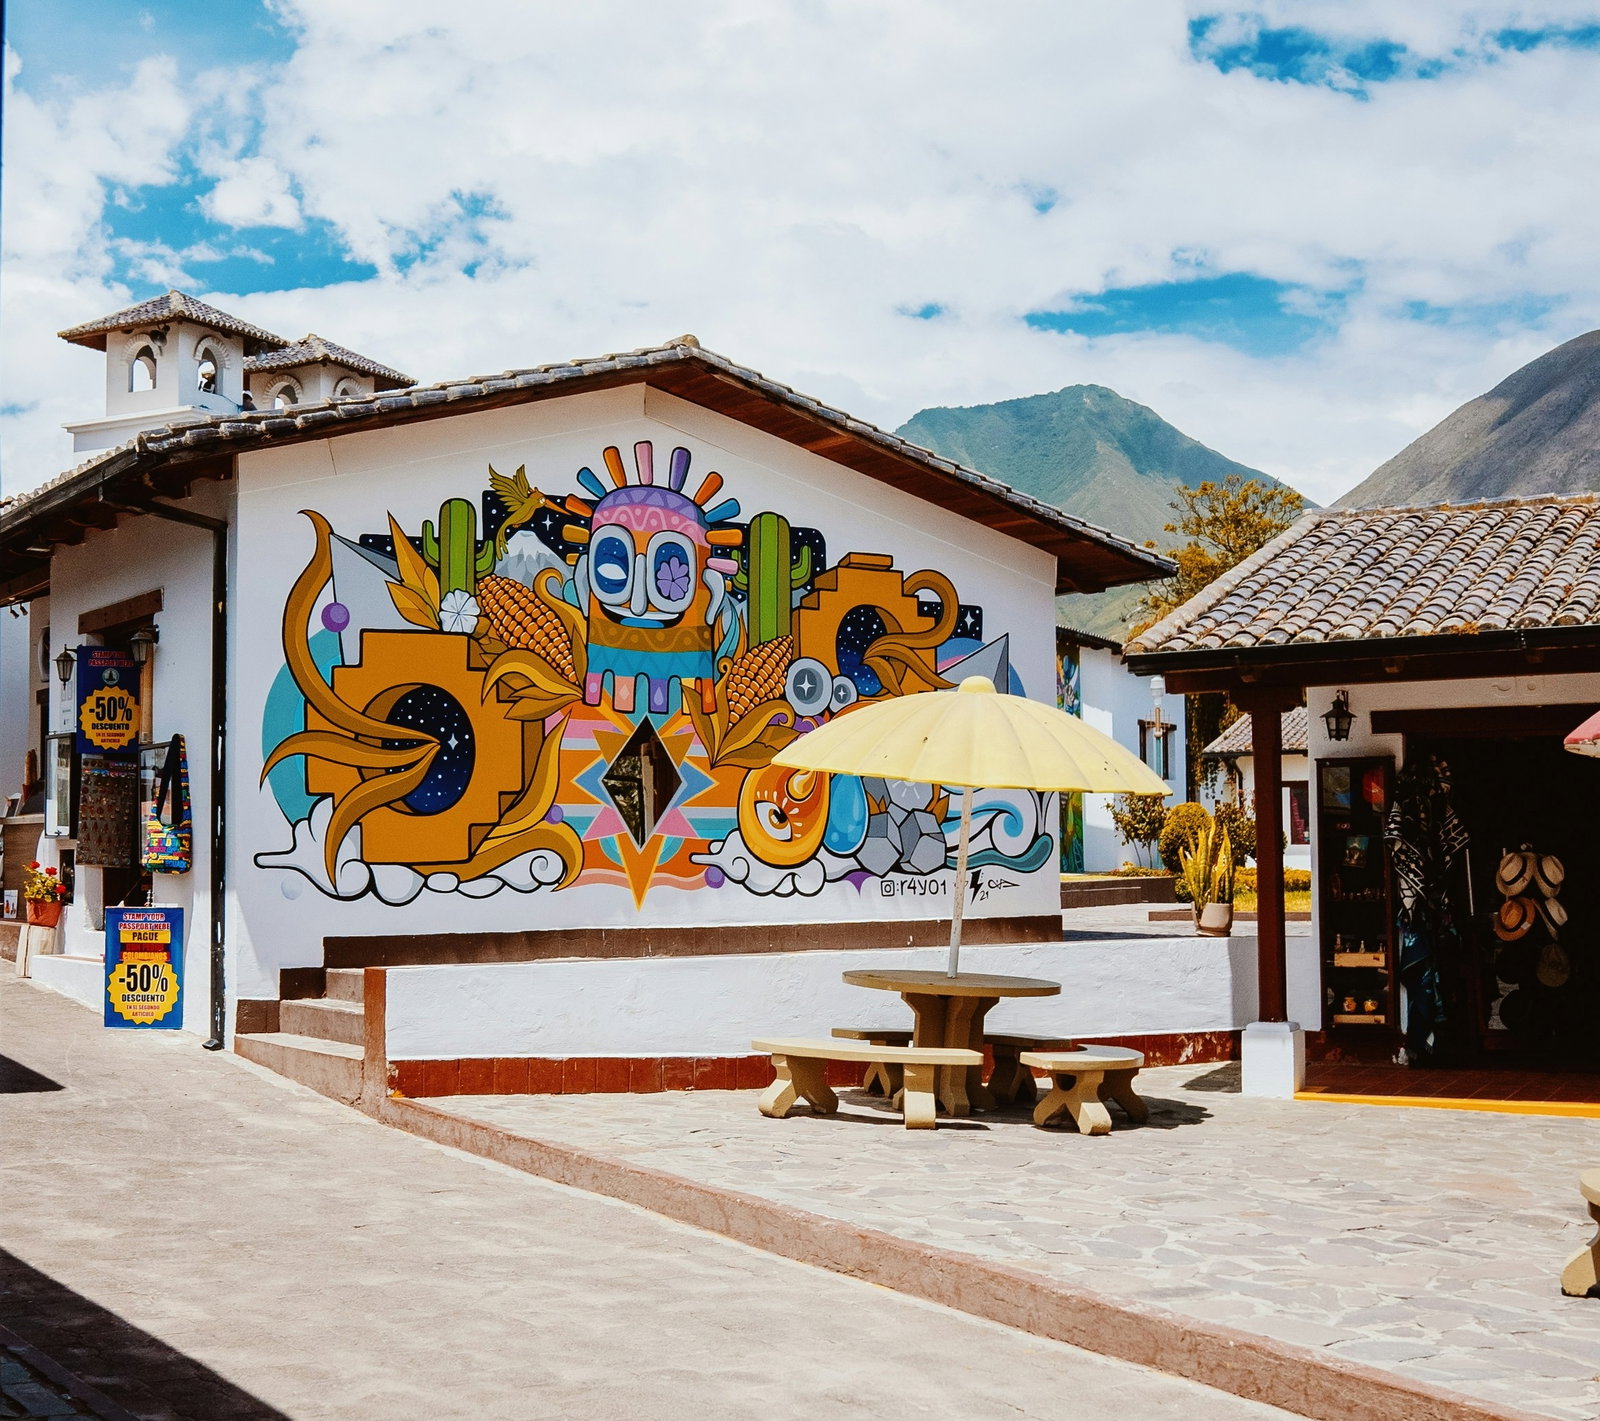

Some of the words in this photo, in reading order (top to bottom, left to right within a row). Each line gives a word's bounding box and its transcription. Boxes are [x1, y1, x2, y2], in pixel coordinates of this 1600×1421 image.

[88, 696, 133, 722] -50%
[91, 723, 130, 731] DESCUENTO
[123, 912, 145, 921] STAMP
[146, 912, 166, 921] YOUR
[118, 922, 153, 931] PASSPORT
[154, 922, 171, 931] HERE
[132, 932, 159, 941] PAGUE
[122, 951, 168, 961] COLOMBIANOS
[118, 964, 168, 992] -50%
[121, 994, 165, 1002] DESCUENTO
